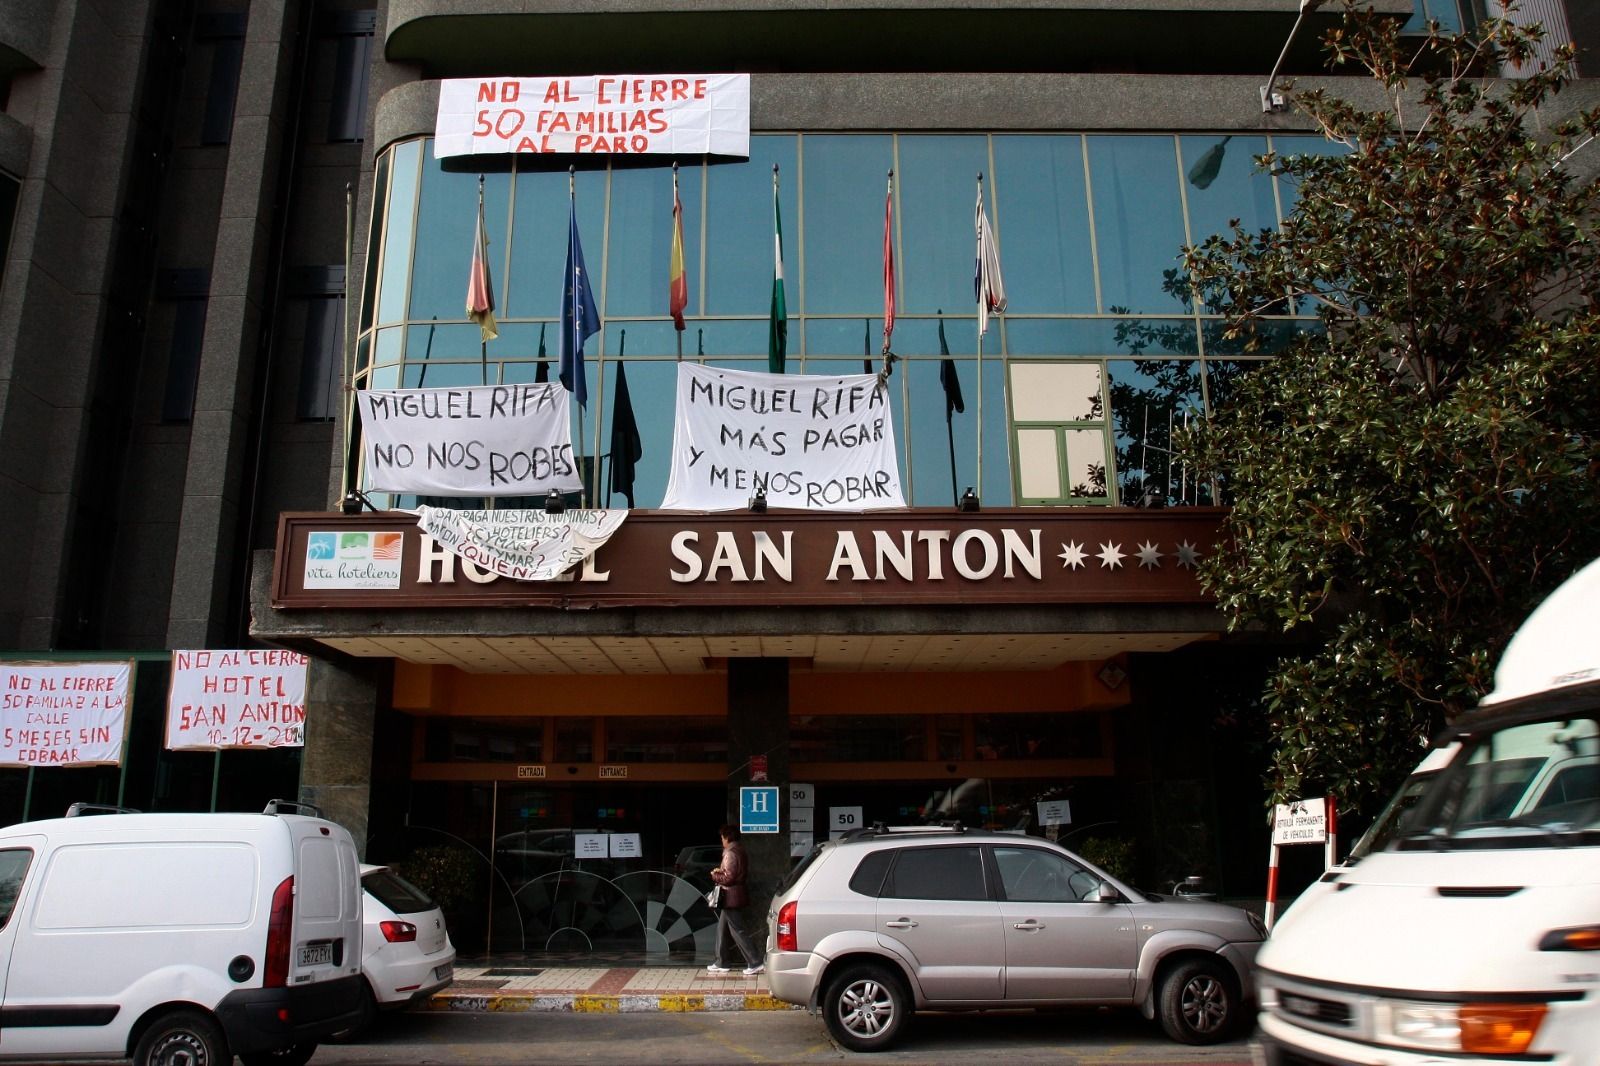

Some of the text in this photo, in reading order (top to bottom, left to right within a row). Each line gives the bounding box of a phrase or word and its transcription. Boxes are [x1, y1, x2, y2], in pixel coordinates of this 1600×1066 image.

[477, 78, 707, 105] NO AL CIERRE
[472, 108, 669, 140] 50 FAMILIAS
[515, 134, 649, 153] AL PARO
[720, 417, 884, 456] MÁS PAGAR
[374, 440, 573, 487] NO NOS ROBES
[709, 464, 891, 508] MENOS ROBAR
[491, 510, 546, 524] NUESTRAS
[669, 530, 793, 583] SAN
[825, 528, 1042, 582] ANTON
[307, 562, 398, 579] vita hoteliers
[178, 650, 308, 670] NO AL CIERRE
[8, 675, 116, 692] NO AL CIERRE
[204, 676, 286, 697] HOTEL
[91, 696, 99, 708] A
[104, 695, 123, 709] LA
[27, 713, 70, 724] CALLE
[179, 701, 306, 731] SAN ANTON
[3, 725, 110, 748] 5 MESES SIN
[18, 748, 81, 763] COBRAR
[519, 767, 545, 777] ENTRADA
[600, 767, 626, 777] ENTRANCE
[751, 791, 769, 813] H
[791, 790, 806, 800] 50
[838, 814, 855, 824] 50
